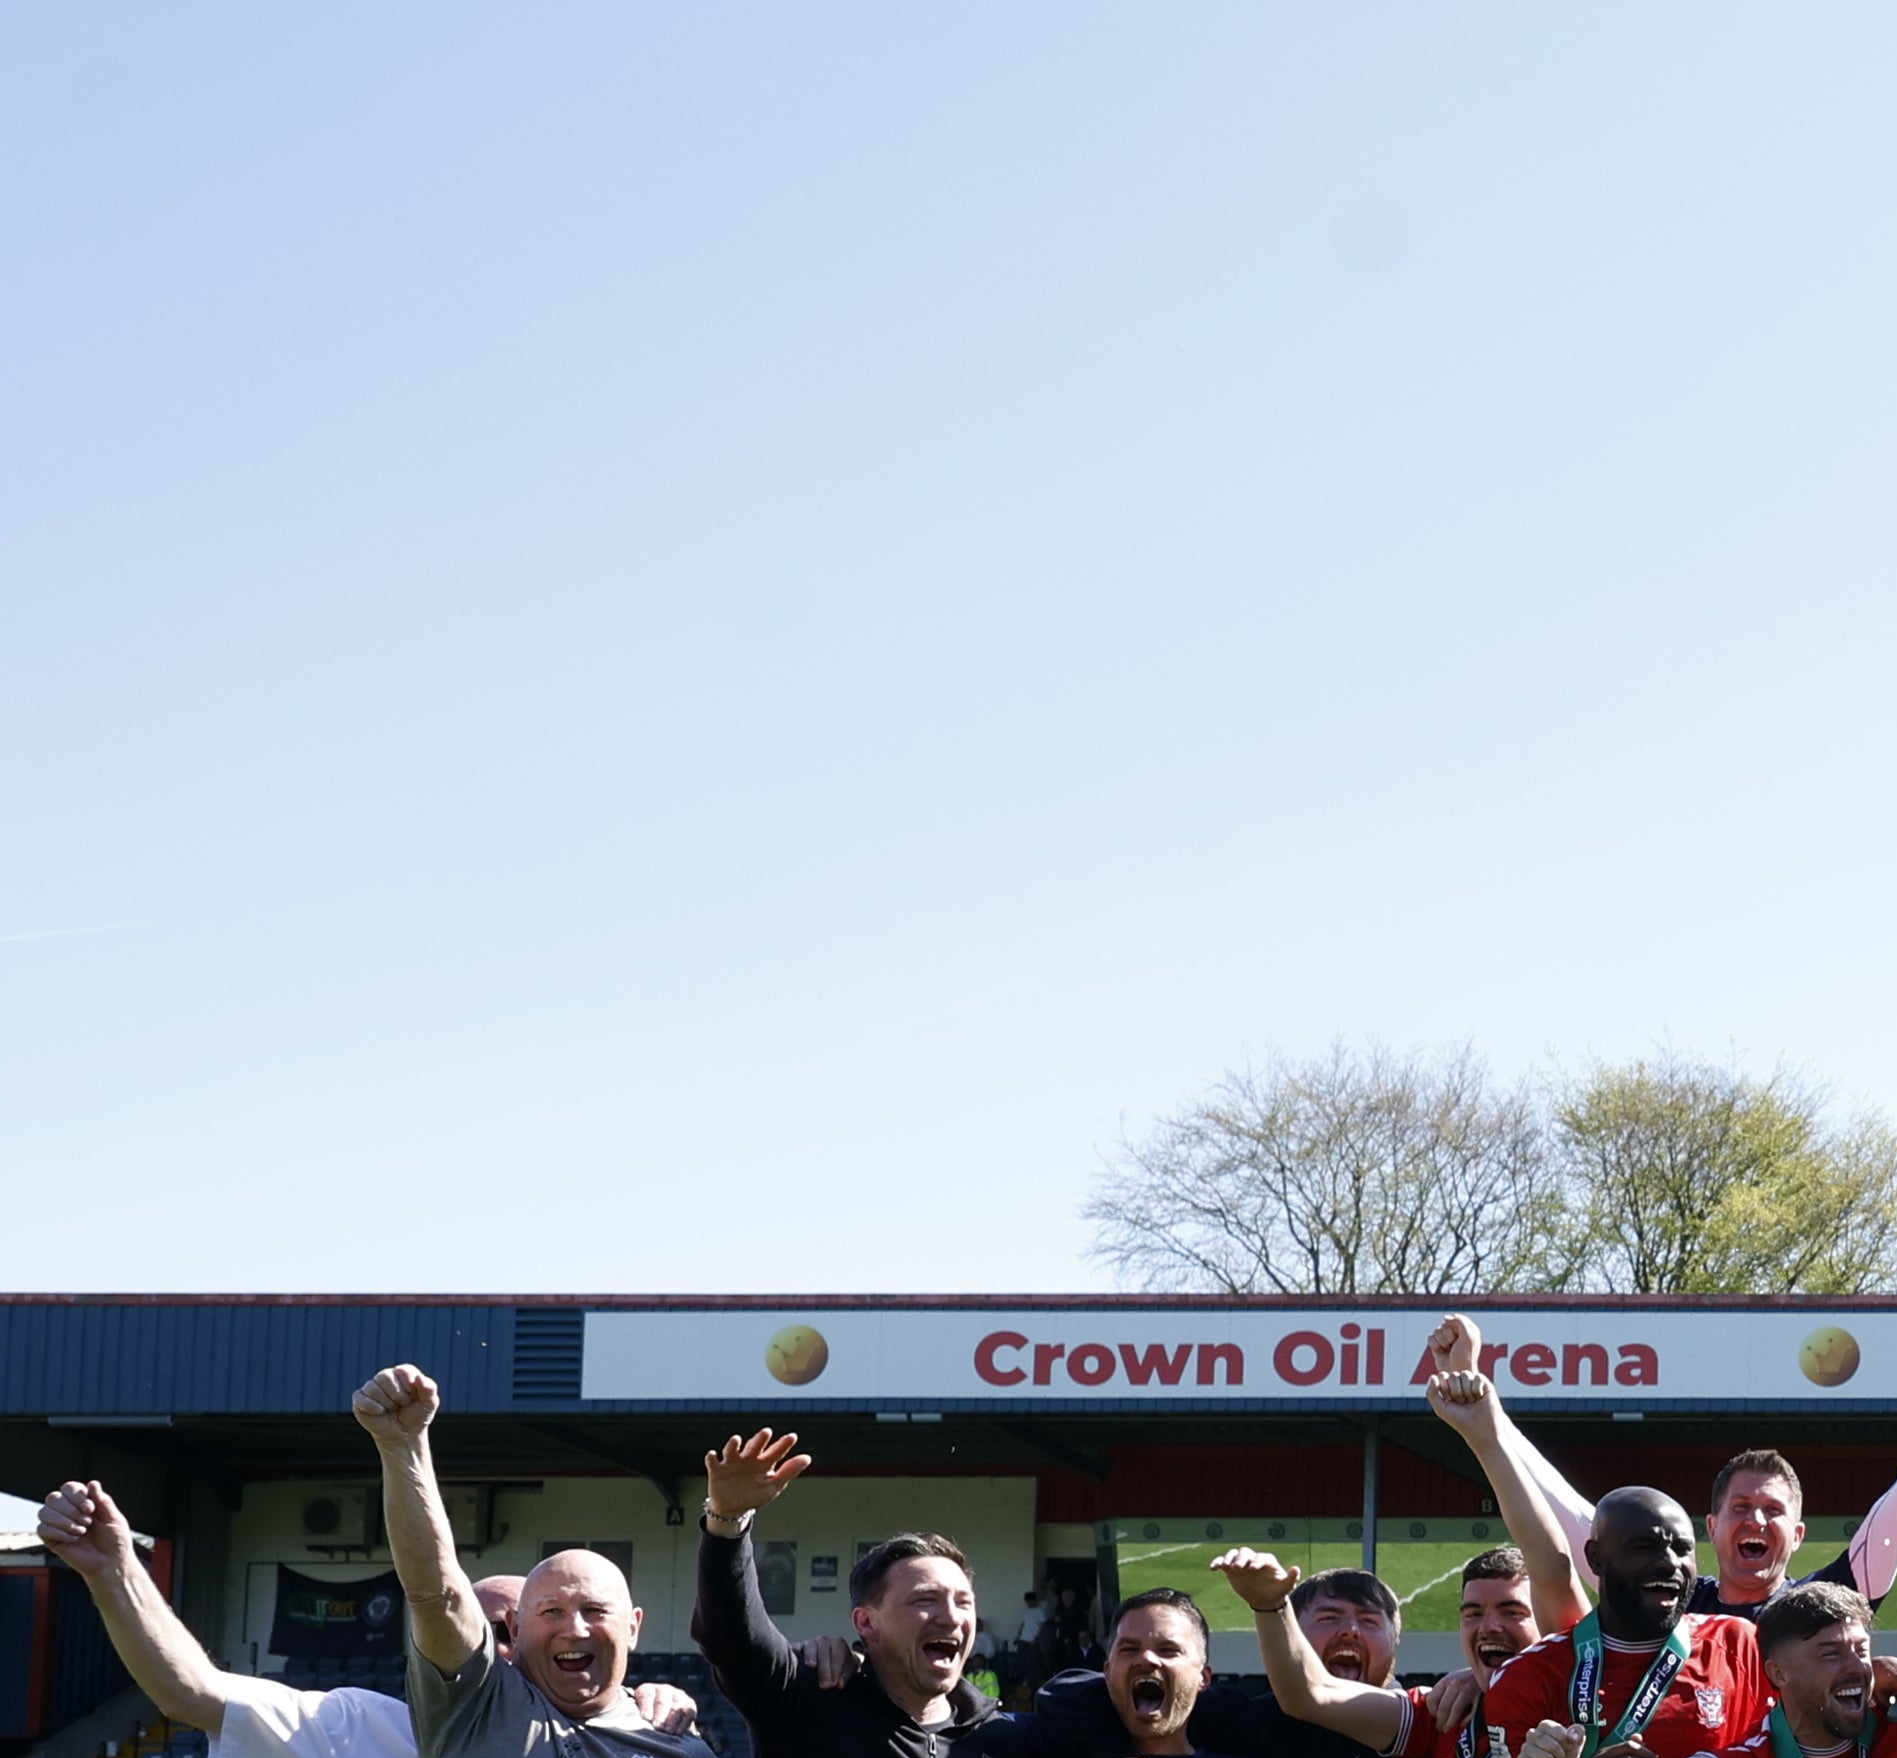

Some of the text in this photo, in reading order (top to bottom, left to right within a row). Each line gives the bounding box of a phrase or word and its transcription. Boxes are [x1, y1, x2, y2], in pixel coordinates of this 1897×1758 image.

[973, 1323, 1659, 1387] Crown Oil rena
[1577, 1645, 1596, 1723] enterprise
[1622, 1653, 1677, 1738] enterprise
